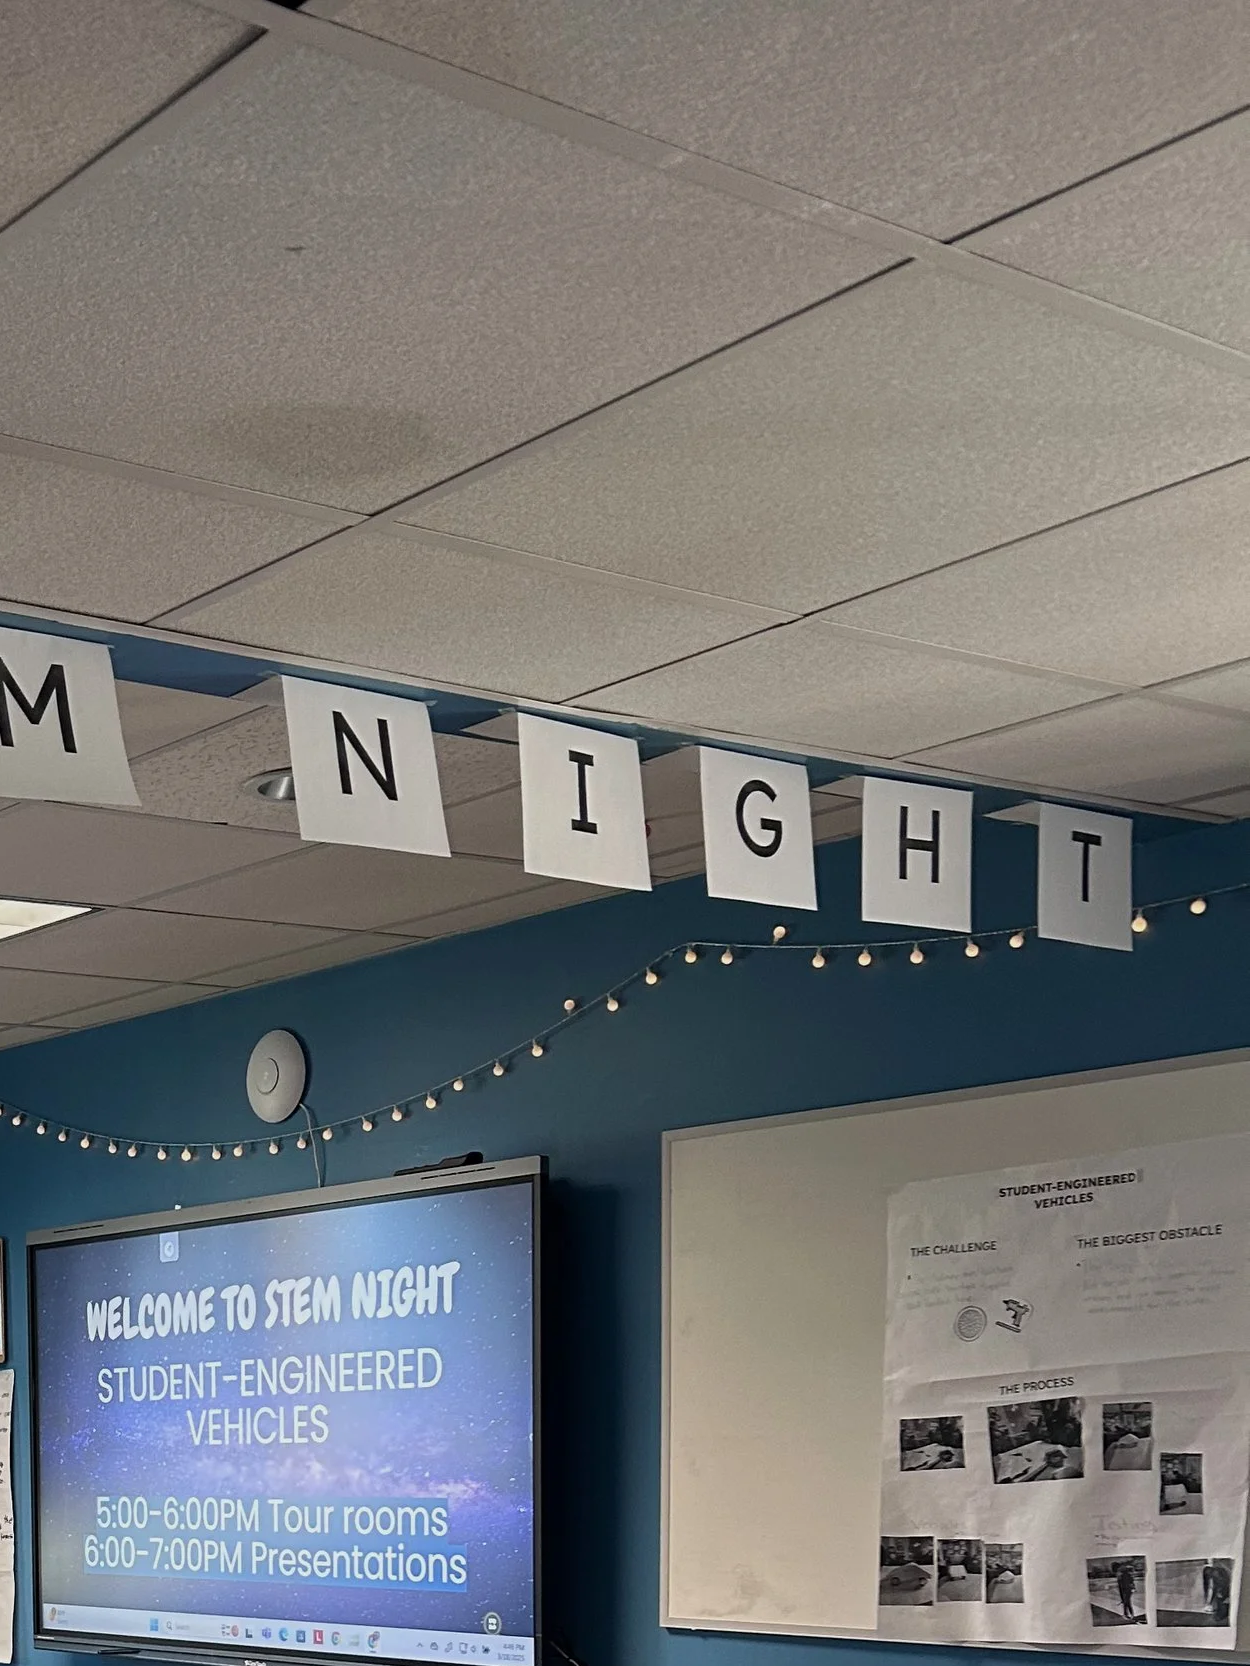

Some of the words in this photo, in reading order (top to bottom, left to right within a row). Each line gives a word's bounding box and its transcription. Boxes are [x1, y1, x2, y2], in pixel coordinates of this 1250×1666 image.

[998, 1171, 1136, 1199] STUDENT-ENGINEERED
[1034, 1191, 1094, 1210] VEHICLES
[910, 1246, 931, 1258] THE
[932, 1241, 998, 1256] CHALLENGE
[1076, 1237, 1100, 1250] THE
[1102, 1231, 1156, 1247] BIGGEST
[1158, 1224, 1224, 1241] OBSTACLE
[86, 1286, 215, 1343] WELCOME
[221, 1283, 257, 1332] TO
[264, 1274, 342, 1329] STEM
[351, 1261, 462, 1320] NIGHT
[97, 1347, 443, 1403] STUDENT-ENGINEERED
[998, 1383, 1021, 1396] THE
[1023, 1376, 1075, 1393] PROCESS
[187, 1404, 330, 1446] VEHICLES
[96, 1496, 260, 1533] 5:00-6:00PM
[268, 1498, 334, 1535] Tour
[342, 1507, 448, 1537] rooms
[84, 1535, 242, 1575] 6:00-7:00PM
[251, 1541, 467, 1584] Presentations
